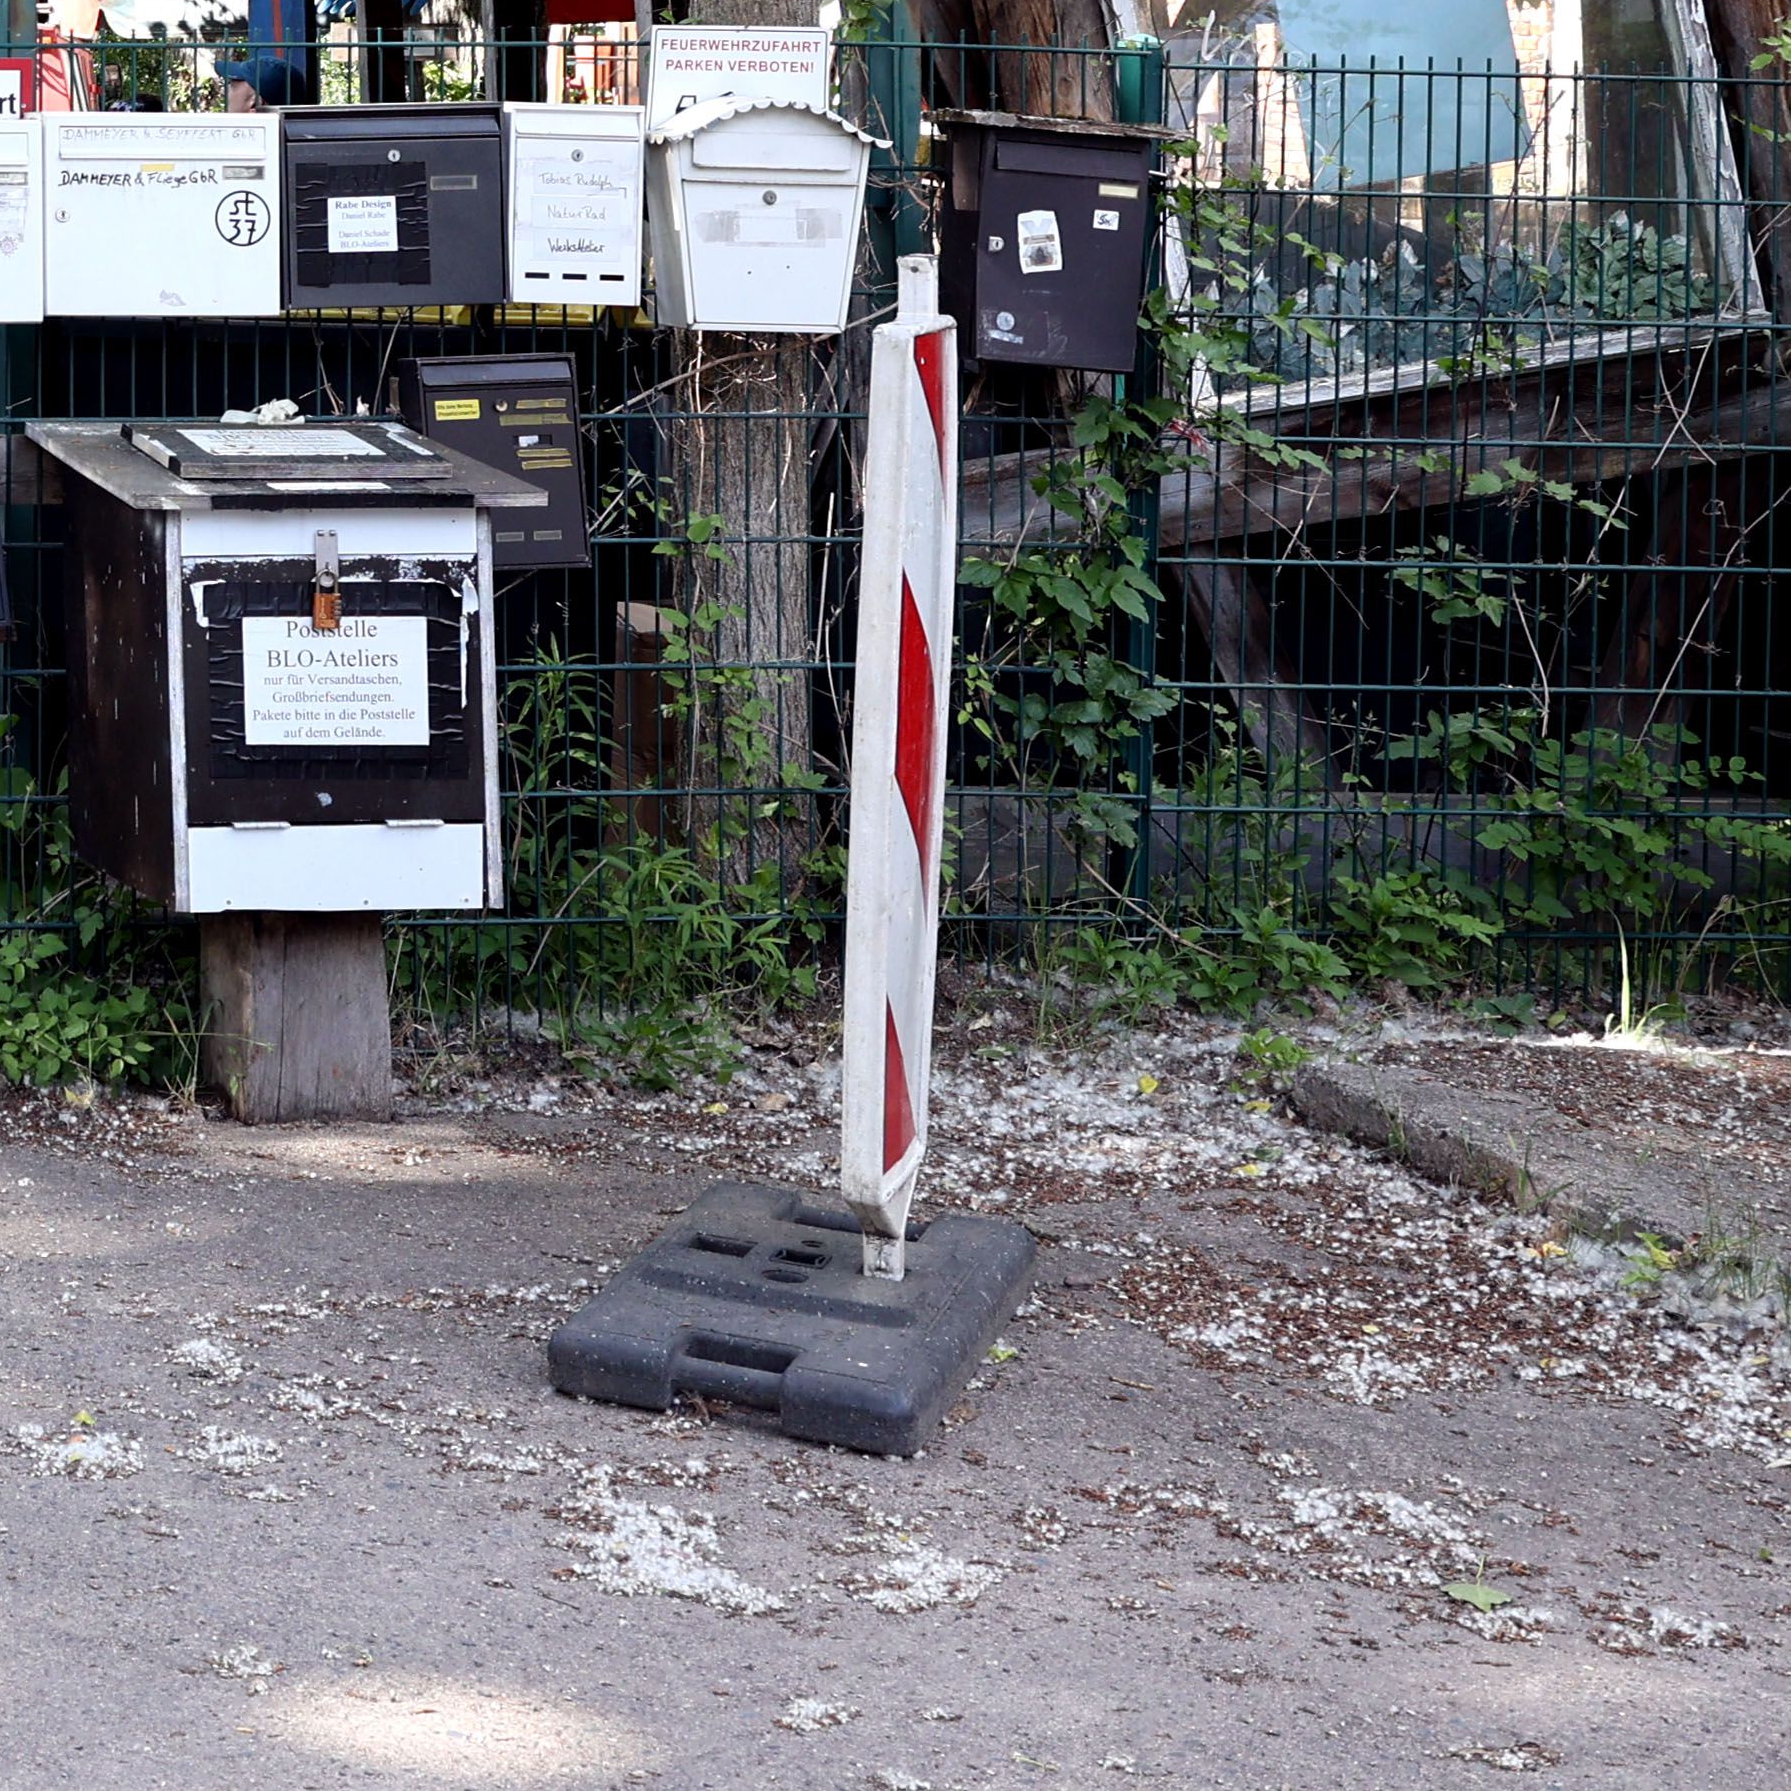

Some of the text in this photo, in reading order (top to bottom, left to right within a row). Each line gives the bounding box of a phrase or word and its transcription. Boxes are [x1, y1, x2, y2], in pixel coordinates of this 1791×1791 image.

[660, 38, 821, 53] FEUERWEHRZUFAHRT
[665, 59, 814, 73] PARKEN VERBOTEN!
[58, 171, 132, 186] DAMMEYER
[134, 173, 145, 187] &
[189, 168, 218, 185] GbR
[335, 199, 392, 210] Rabe Design
[228, 219, 257, 245] 37
[286, 619, 378, 638] Poststelle
[267, 649, 399, 668] BLO-Ateliers
[264, 673, 402, 686] nur für Versandtaschen,
[272, 691, 395, 705] Großbriefsendungen.
[252, 709, 416, 721] Pakete bitte in die Poststelle
[283, 725, 386, 738] auf dem Gelände.
